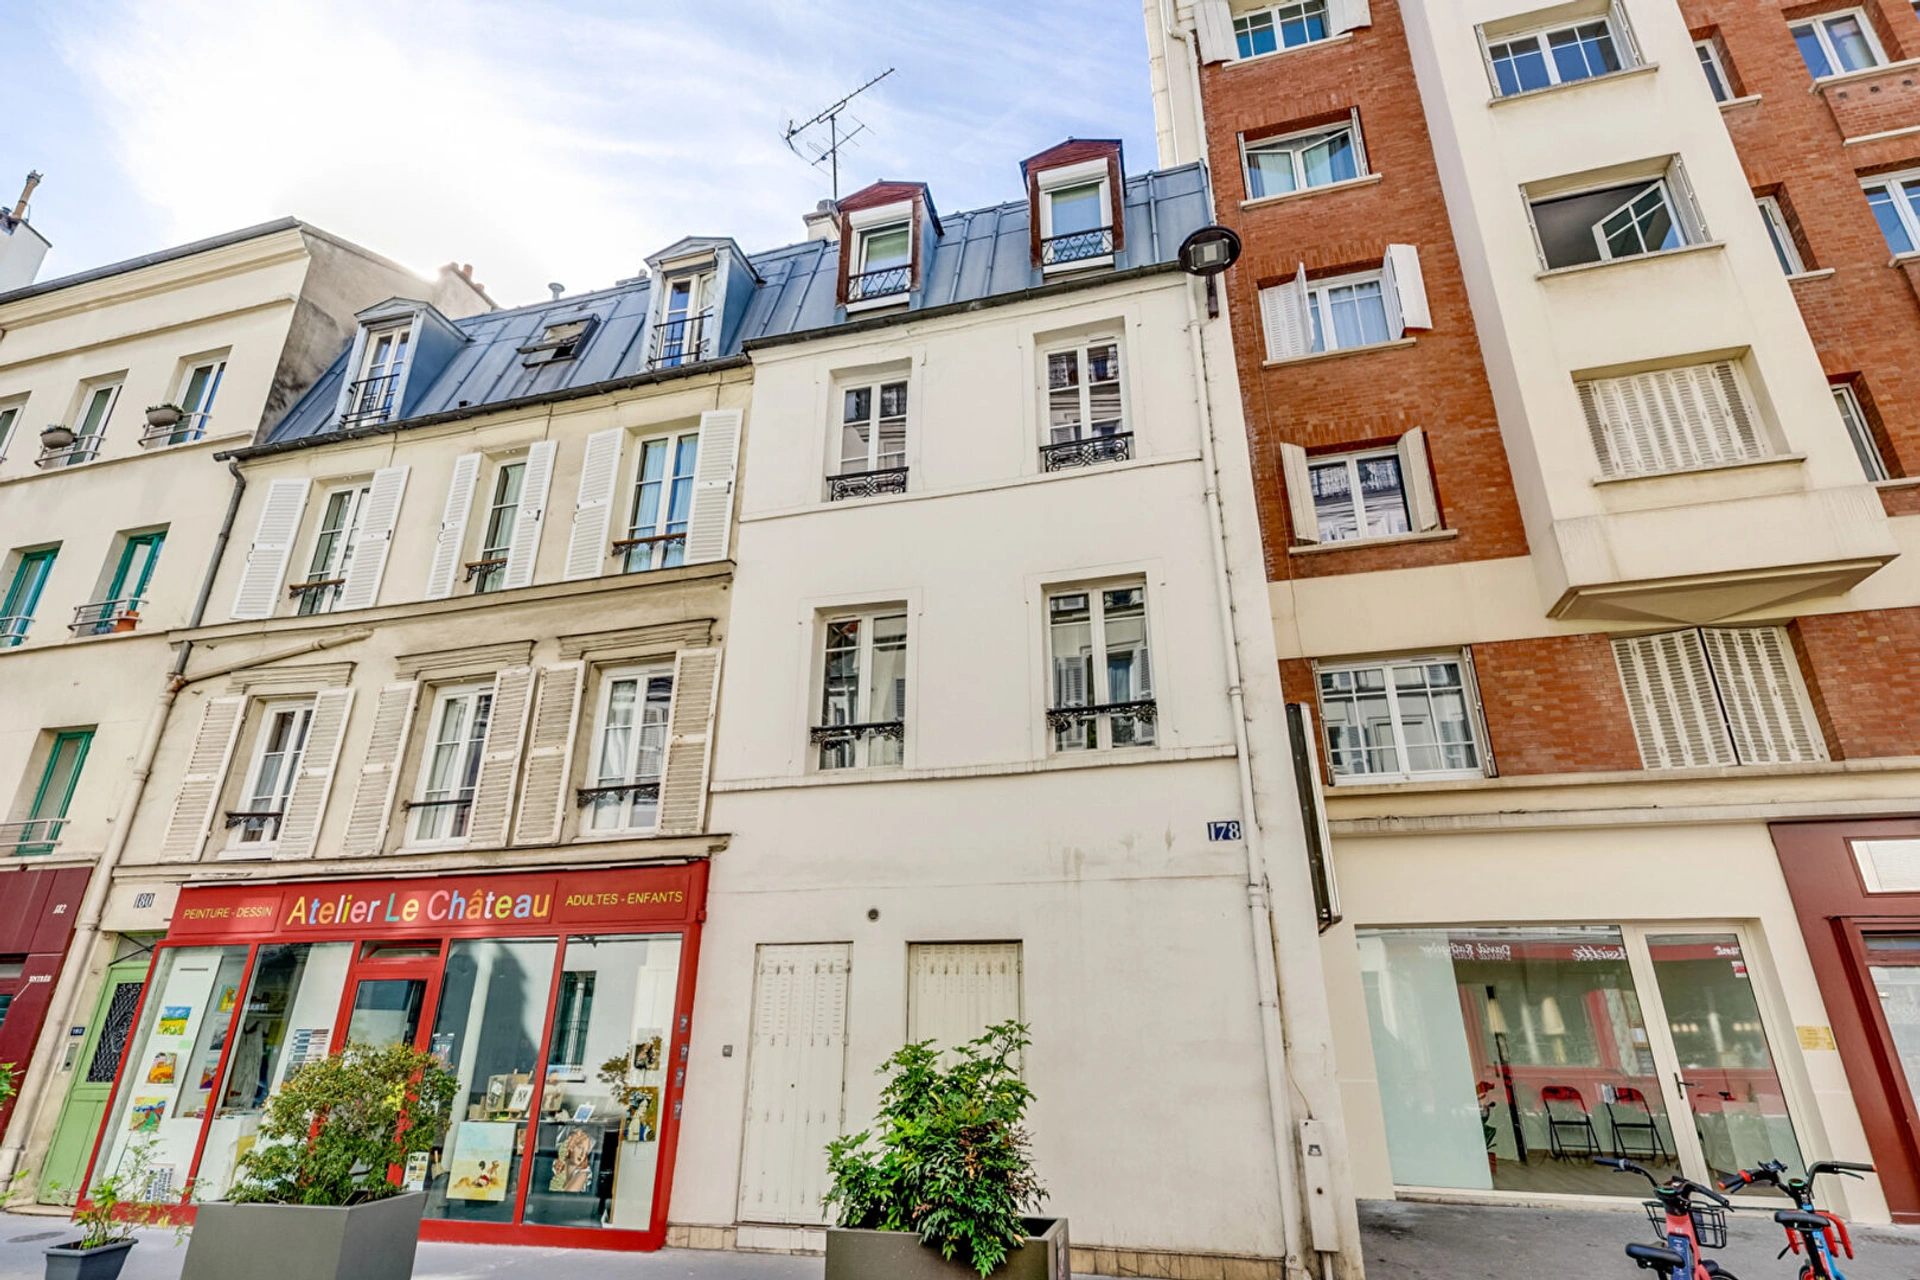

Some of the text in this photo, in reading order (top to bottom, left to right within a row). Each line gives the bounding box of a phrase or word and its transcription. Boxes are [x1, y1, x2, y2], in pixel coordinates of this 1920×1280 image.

[1209, 822, 1240, 841] 178
[134, 893, 154, 908] 180
[286, 888, 551, 926] Atelier Le Château
[565, 893, 619, 907] ADULTES
[627, 890, 684, 905] ENFANTS
[183, 907, 232, 920] PEINTURE
[236, 905, 273, 918] DESSIN
